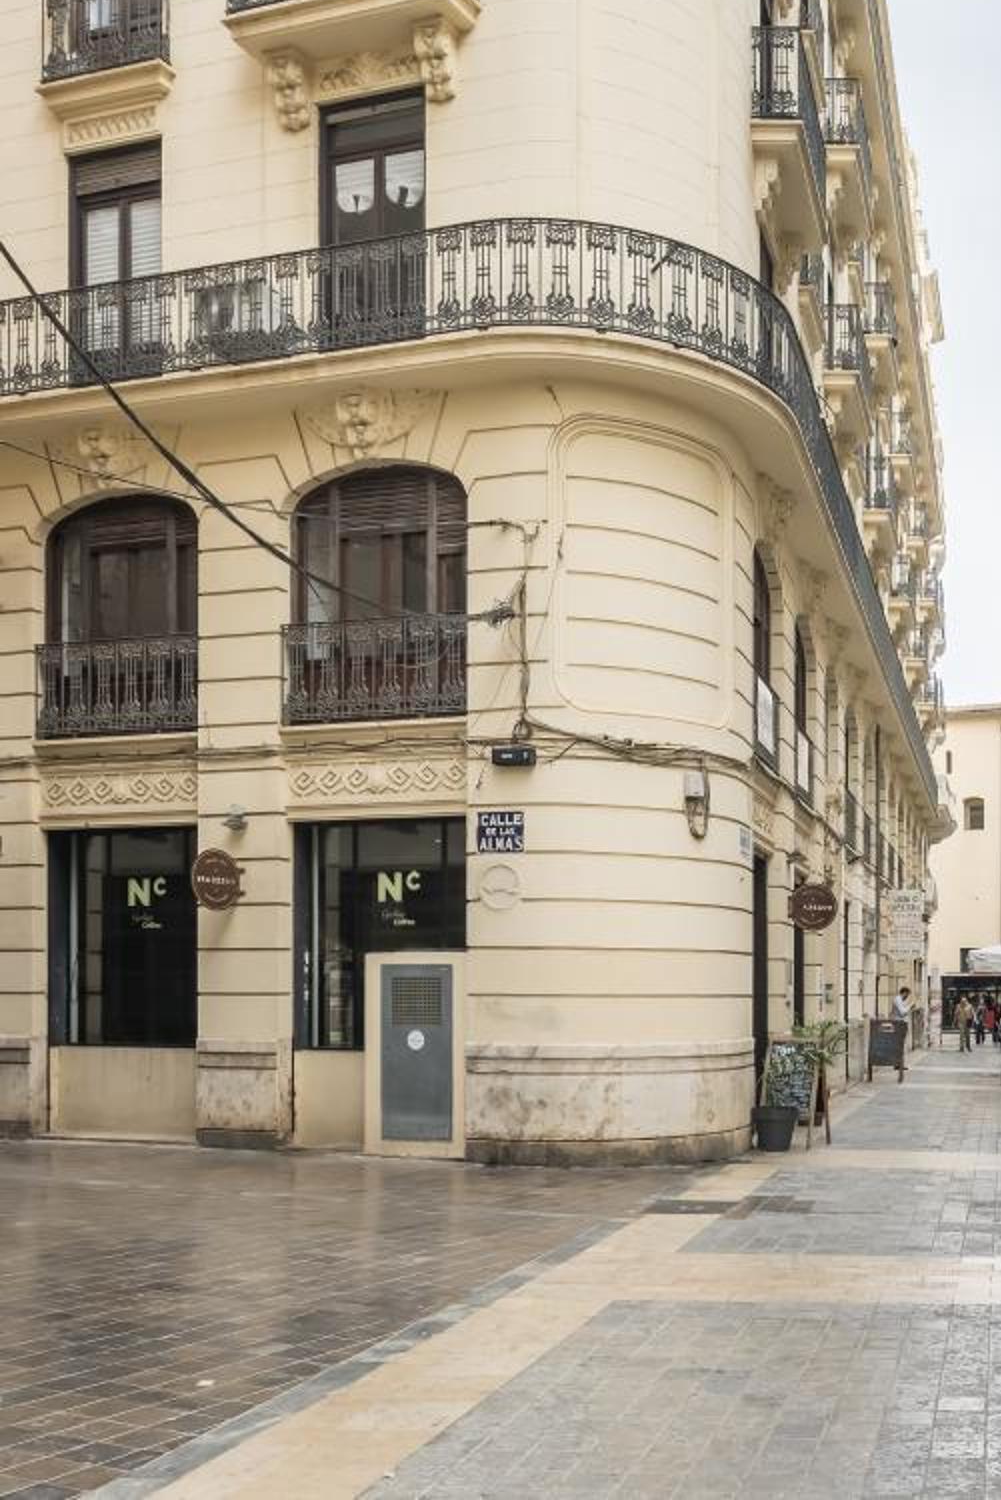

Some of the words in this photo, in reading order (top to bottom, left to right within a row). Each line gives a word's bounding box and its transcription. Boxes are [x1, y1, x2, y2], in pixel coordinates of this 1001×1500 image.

[481, 813, 522, 826] CALLE
[485, 827, 497, 836] DE
[480, 836, 523, 850] ALMAS
